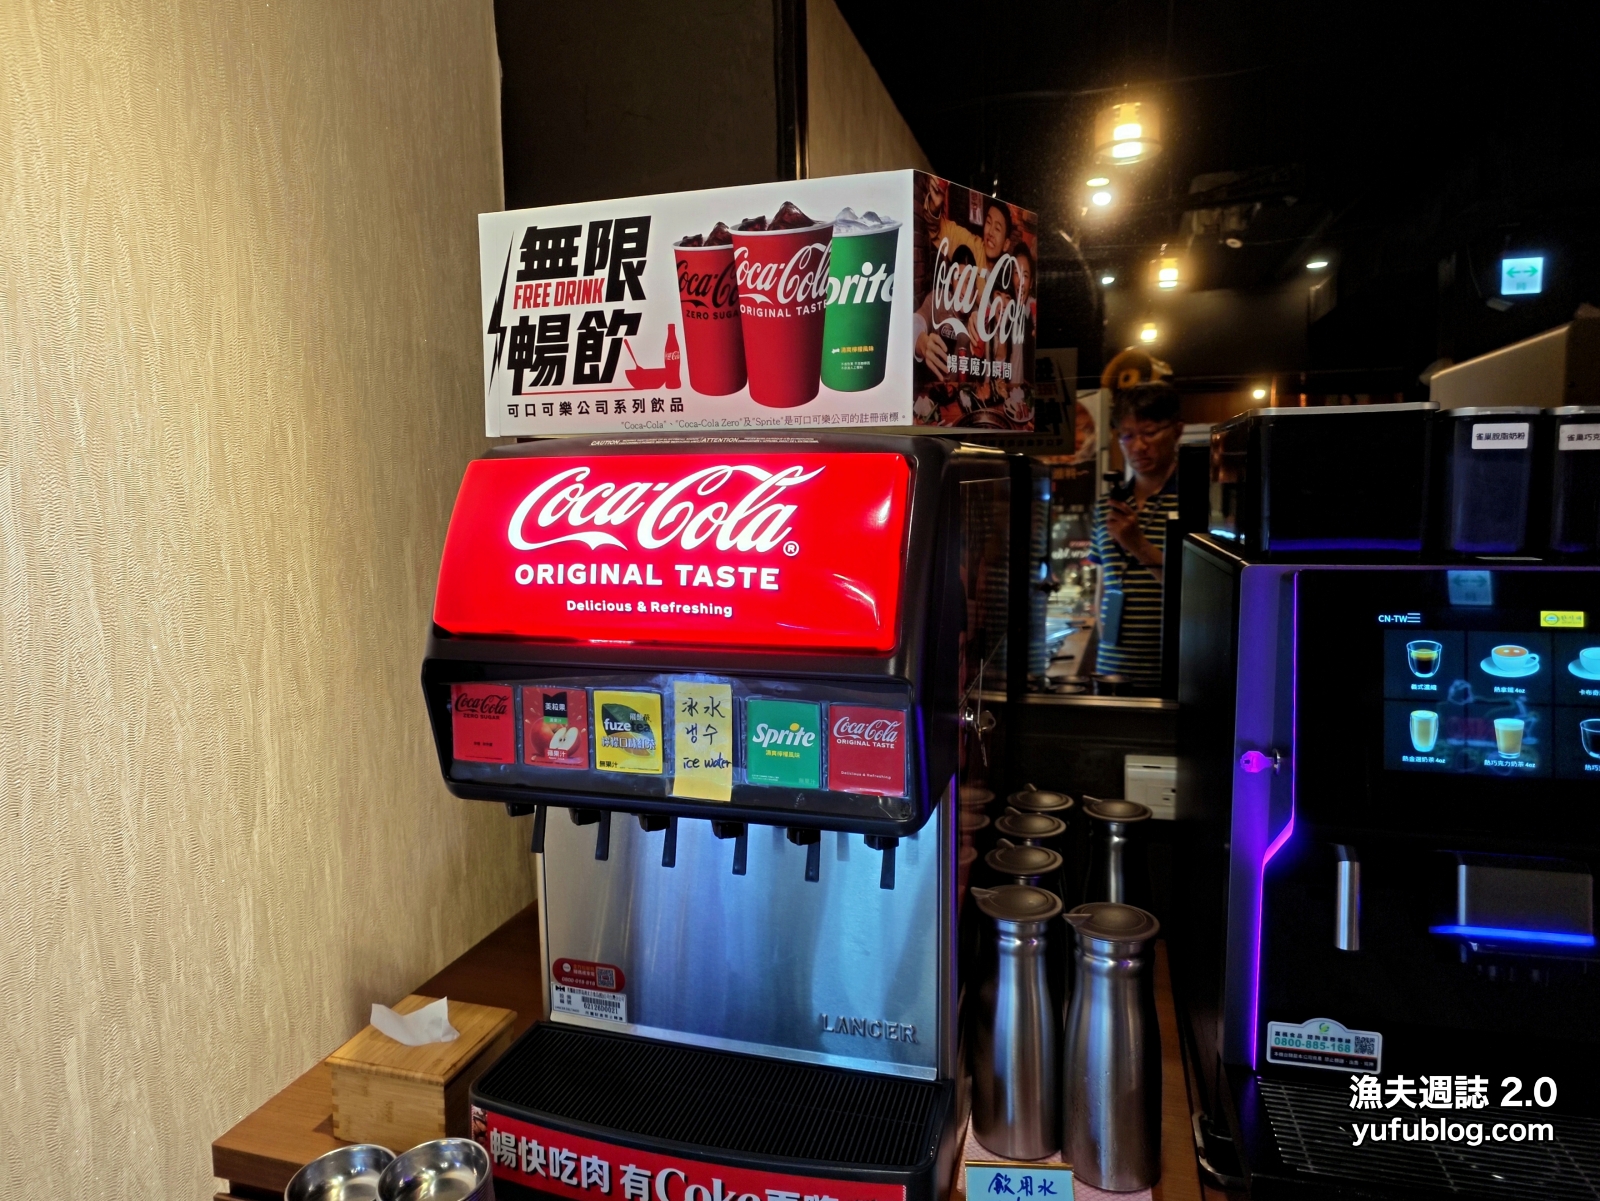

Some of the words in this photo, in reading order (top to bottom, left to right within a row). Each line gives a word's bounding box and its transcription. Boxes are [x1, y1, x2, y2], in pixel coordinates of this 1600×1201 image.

[515, 215, 652, 303] 無限
[513, 282, 552, 310] FREE
[553, 278, 606, 307] DRINK
[932, 236, 1026, 345] Coca-Cola
[685, 309, 710, 320] ZERO
[712, 309, 740, 320] SUGA
[739, 304, 792, 318] ORIGINAL
[506, 308, 643, 396] 暢飲
[946, 353, 1012, 380] 暢享魔力瞬間
[507, 397, 684, 418] 可口可樂公司系列飲品
[507, 464, 827, 553] Coca-Cola
[514, 563, 663, 587] ORIGINAL
[675, 564, 780, 590] TASTE
[566, 599, 632, 613] Delicious
[637, 601, 648, 612] &
[651, 601, 733, 617] Refreshing
[1378, 614, 1408, 623] CN-TW
[455, 693, 510, 715] Coca-Cola
[752, 722, 816, 748] Sprite
[833, 716, 903, 743] Coca-Cola
[836, 738, 871, 747] ORIGINAL
[872, 741, 895, 749] TASTE
[683, 757, 700, 770] ice
[704, 752, 733, 770] water
[820, 1013, 918, 1043] LANCER
[1274, 1036, 1351, 1053] 0800-885-168
[490, 1127, 610, 1193] 暢快吃肉
[988, 1172, 1058, 1197] 飲用水
